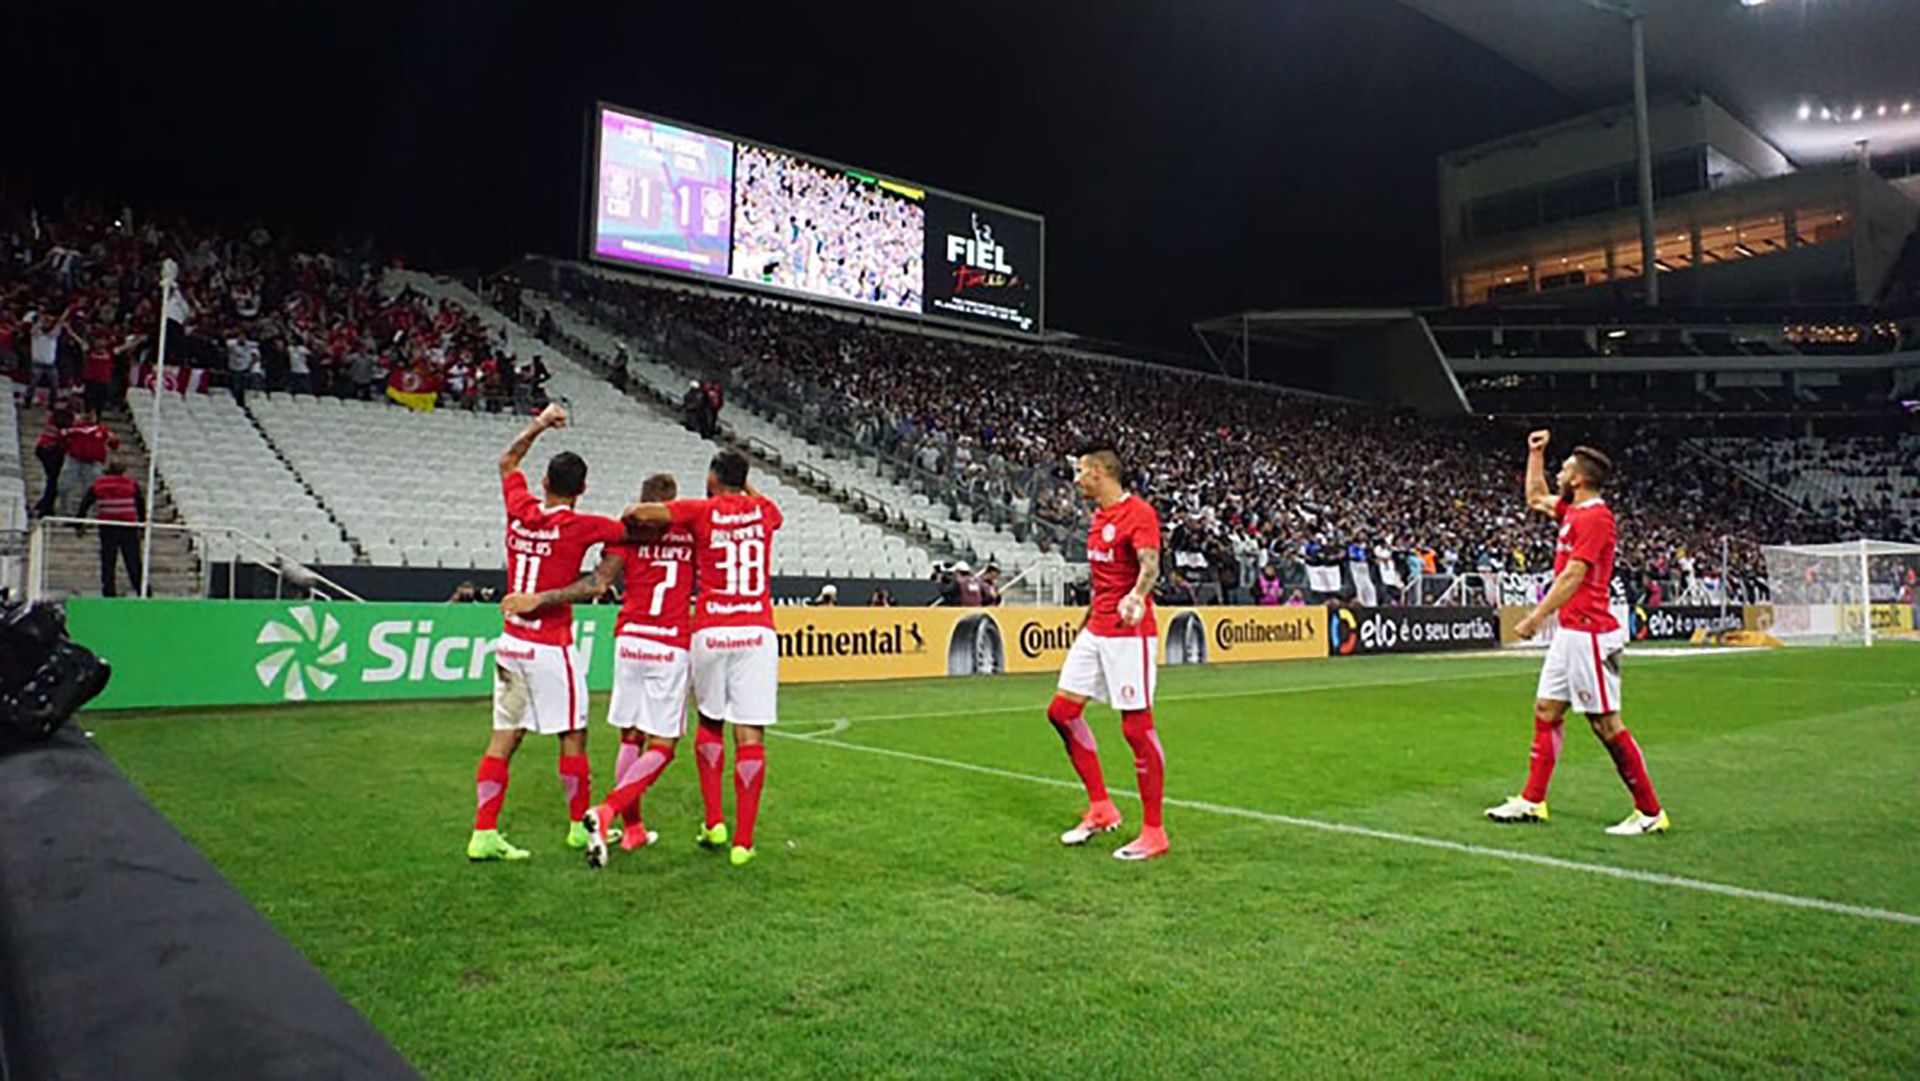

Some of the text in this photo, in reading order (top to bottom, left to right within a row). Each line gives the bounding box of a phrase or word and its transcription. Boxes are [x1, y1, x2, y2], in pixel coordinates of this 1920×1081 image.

[640, 177, 650, 209] 1
[680, 185, 690, 226] 1
[947, 234, 1012, 275] FIEL
[514, 554, 541, 594] 11
[709, 540, 765, 596] 38
[649, 561, 678, 616] 7
[706, 634, 763, 649] Unimed
[778, 624, 902, 657] ntinental
[1216, 617, 1302, 649] Continental
[1360, 614, 1397, 648] elo
[1400, 617, 1410, 642] é
[1412, 625, 1423, 640] o
[1425, 624, 1449, 640] seu
[361, 620, 596, 682] Sicri
[620, 647, 675, 662] Unimed
